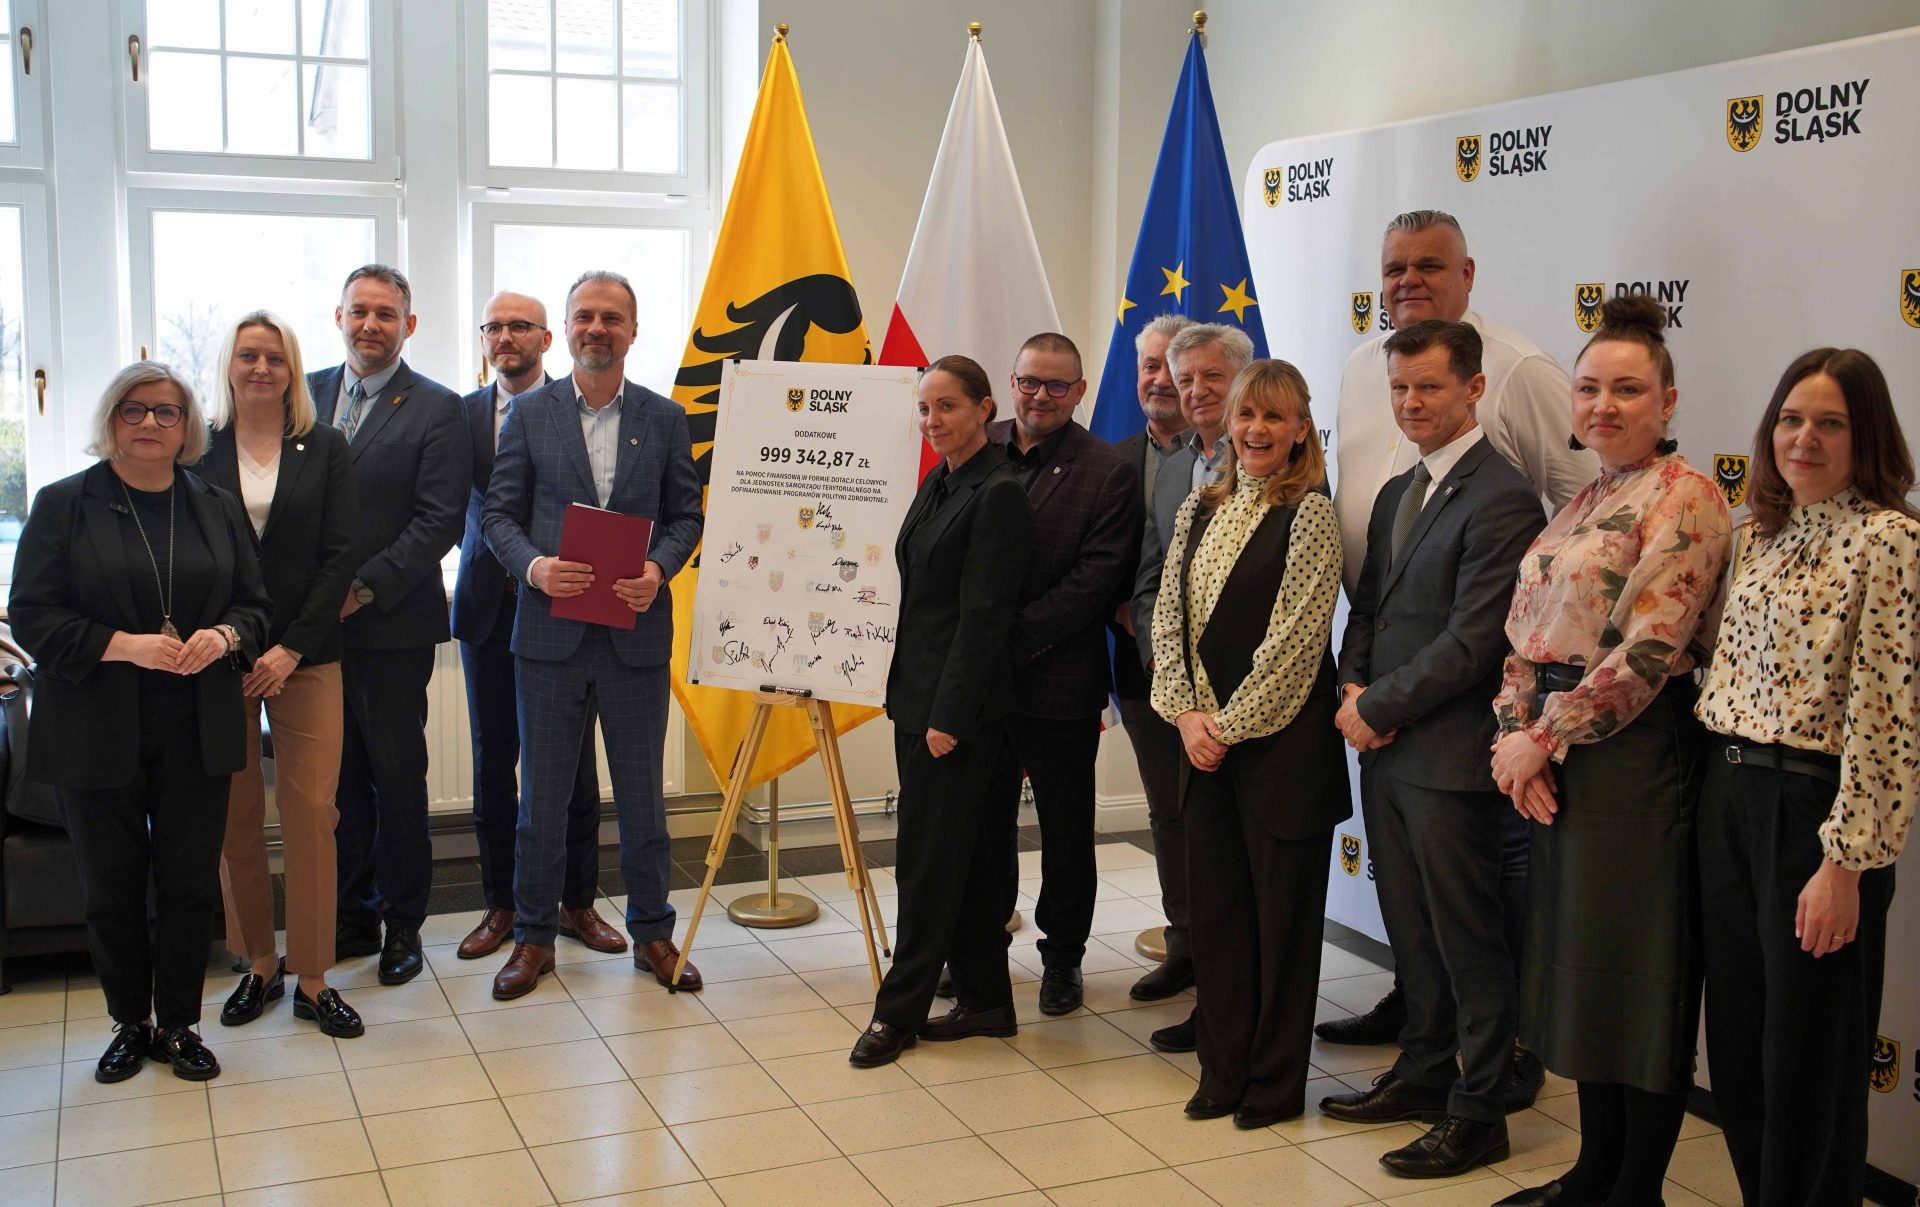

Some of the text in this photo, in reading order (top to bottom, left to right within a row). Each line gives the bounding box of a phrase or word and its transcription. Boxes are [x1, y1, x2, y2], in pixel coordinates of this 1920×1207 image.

[1776, 79, 1870, 116] DOLNY
[1489, 125, 1552, 153] DOLNY
[1774, 109, 1862, 146] ŚLĄSK
[1288, 158, 1334, 183] DOLNY
[1489, 149, 1548, 177] ŚLĄSK
[1287, 178, 1331, 203] ŚLĄSK
[809, 389, 853, 402] DOLNY
[809, 399, 848, 414] ŚLĄSK
[794, 430, 837, 440] DODATKOWE
[760, 446, 871, 470] 999 342,87 ZŁ
[767, 473, 800, 481] FINANSOWĄ
[785, 482, 821, 490] SAMORZĄDU
[822, 485, 871, 494] TERYTORIALNEGO
[731, 487, 781, 495] DOFINANSOWANIE
[783, 490, 820, 498] PROGRAMÓW
[848, 495, 888, 503] ZDROWOTNEJ:
